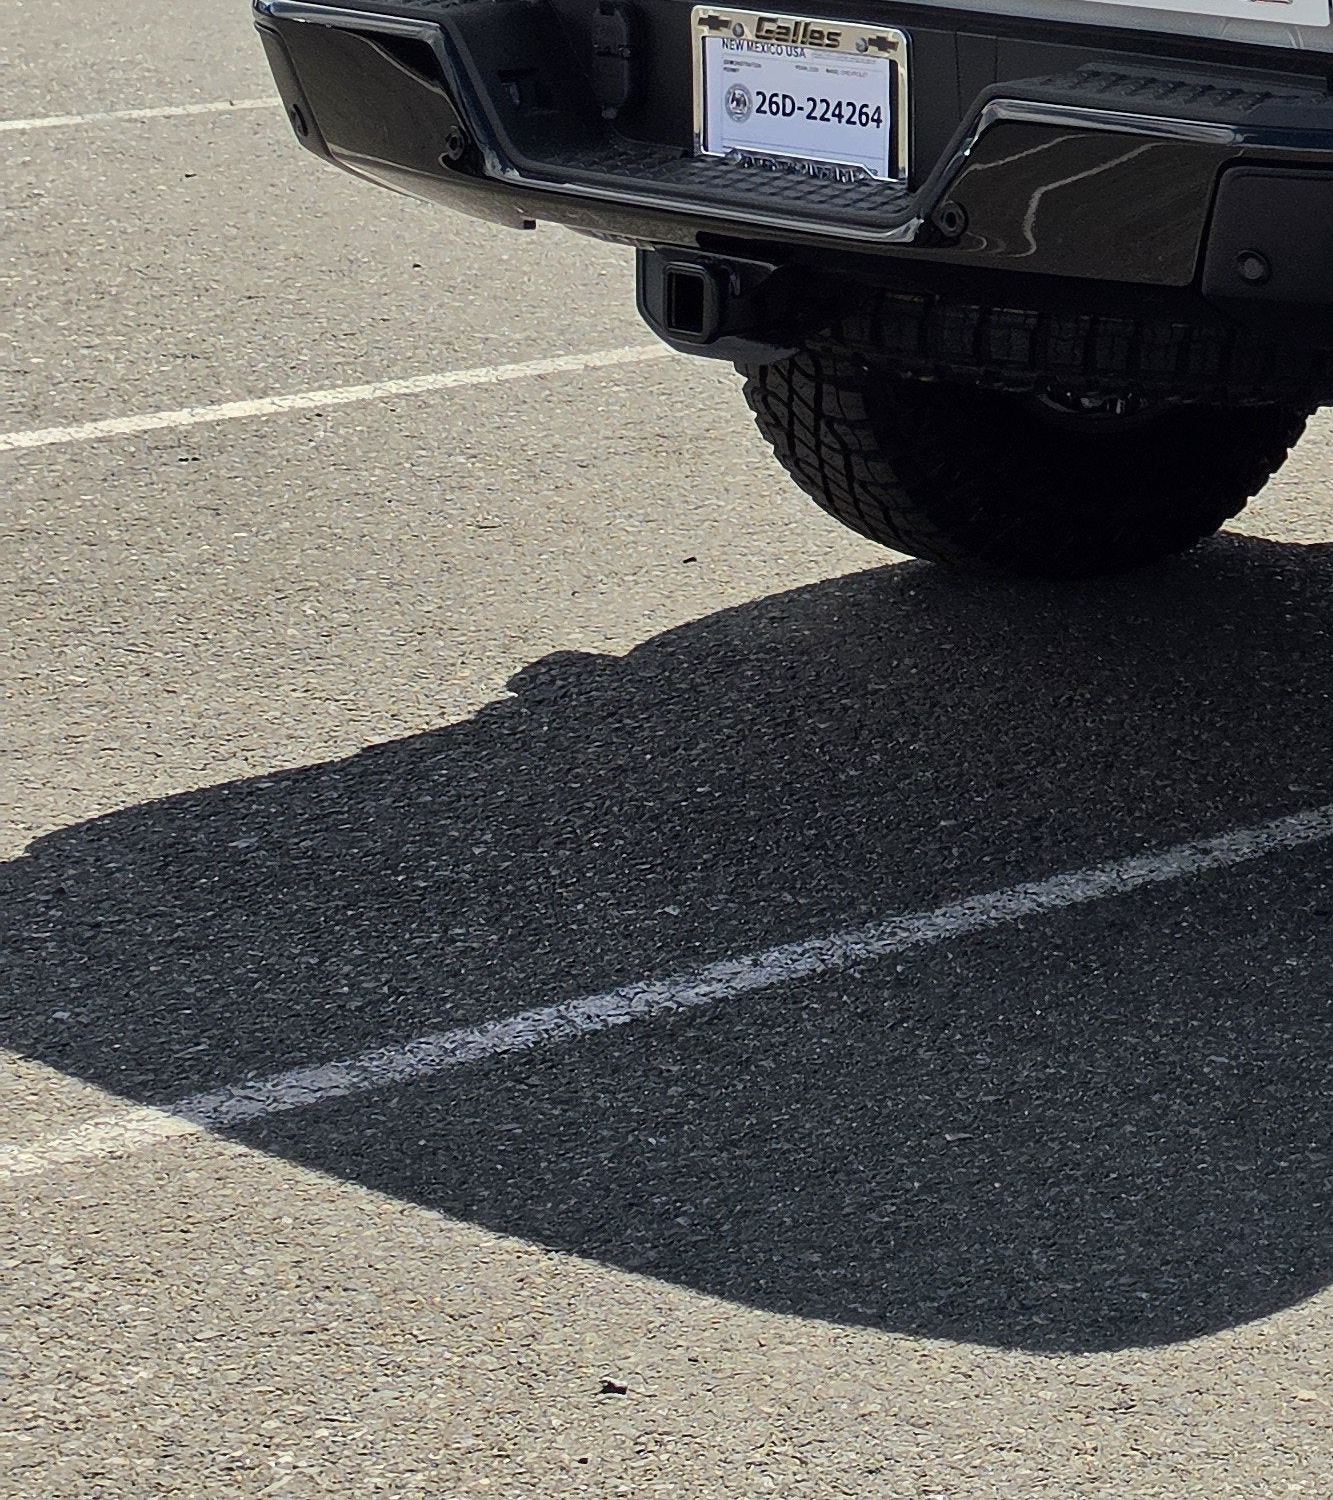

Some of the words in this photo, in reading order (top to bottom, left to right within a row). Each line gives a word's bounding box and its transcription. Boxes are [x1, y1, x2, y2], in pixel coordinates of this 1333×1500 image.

[721, 38, 745, 52] NEW
[746, 41, 784, 58] MEXICO
[785, 45, 807, 59] USA
[755, 16, 842, 49] Galles
[755, 91, 884, 130] 26D-224264
